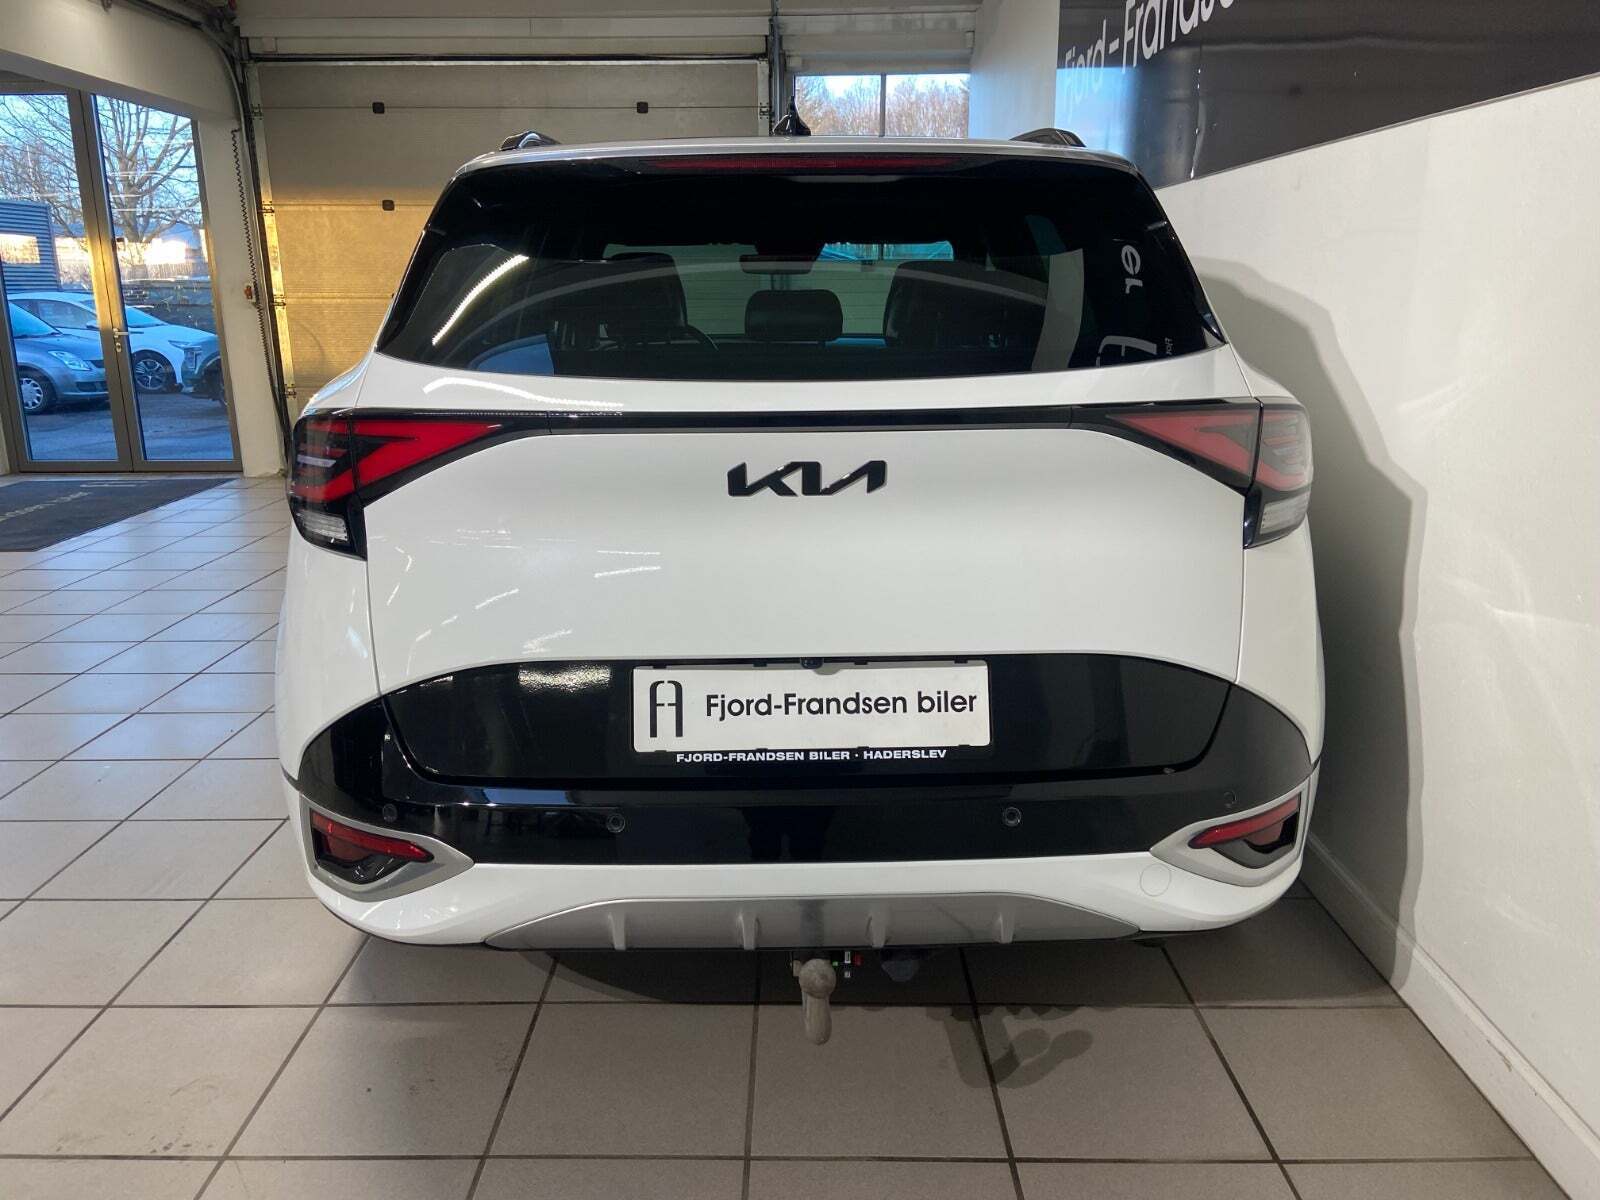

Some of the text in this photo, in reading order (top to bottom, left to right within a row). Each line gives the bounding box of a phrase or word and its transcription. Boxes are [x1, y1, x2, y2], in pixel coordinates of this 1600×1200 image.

[727, 459, 887, 498] KIA
[706, 690, 977, 721] Fjord-Frandsen biler
[676, 749, 947, 763] FJORD-FRANDSEN BILER HADERSLEV
